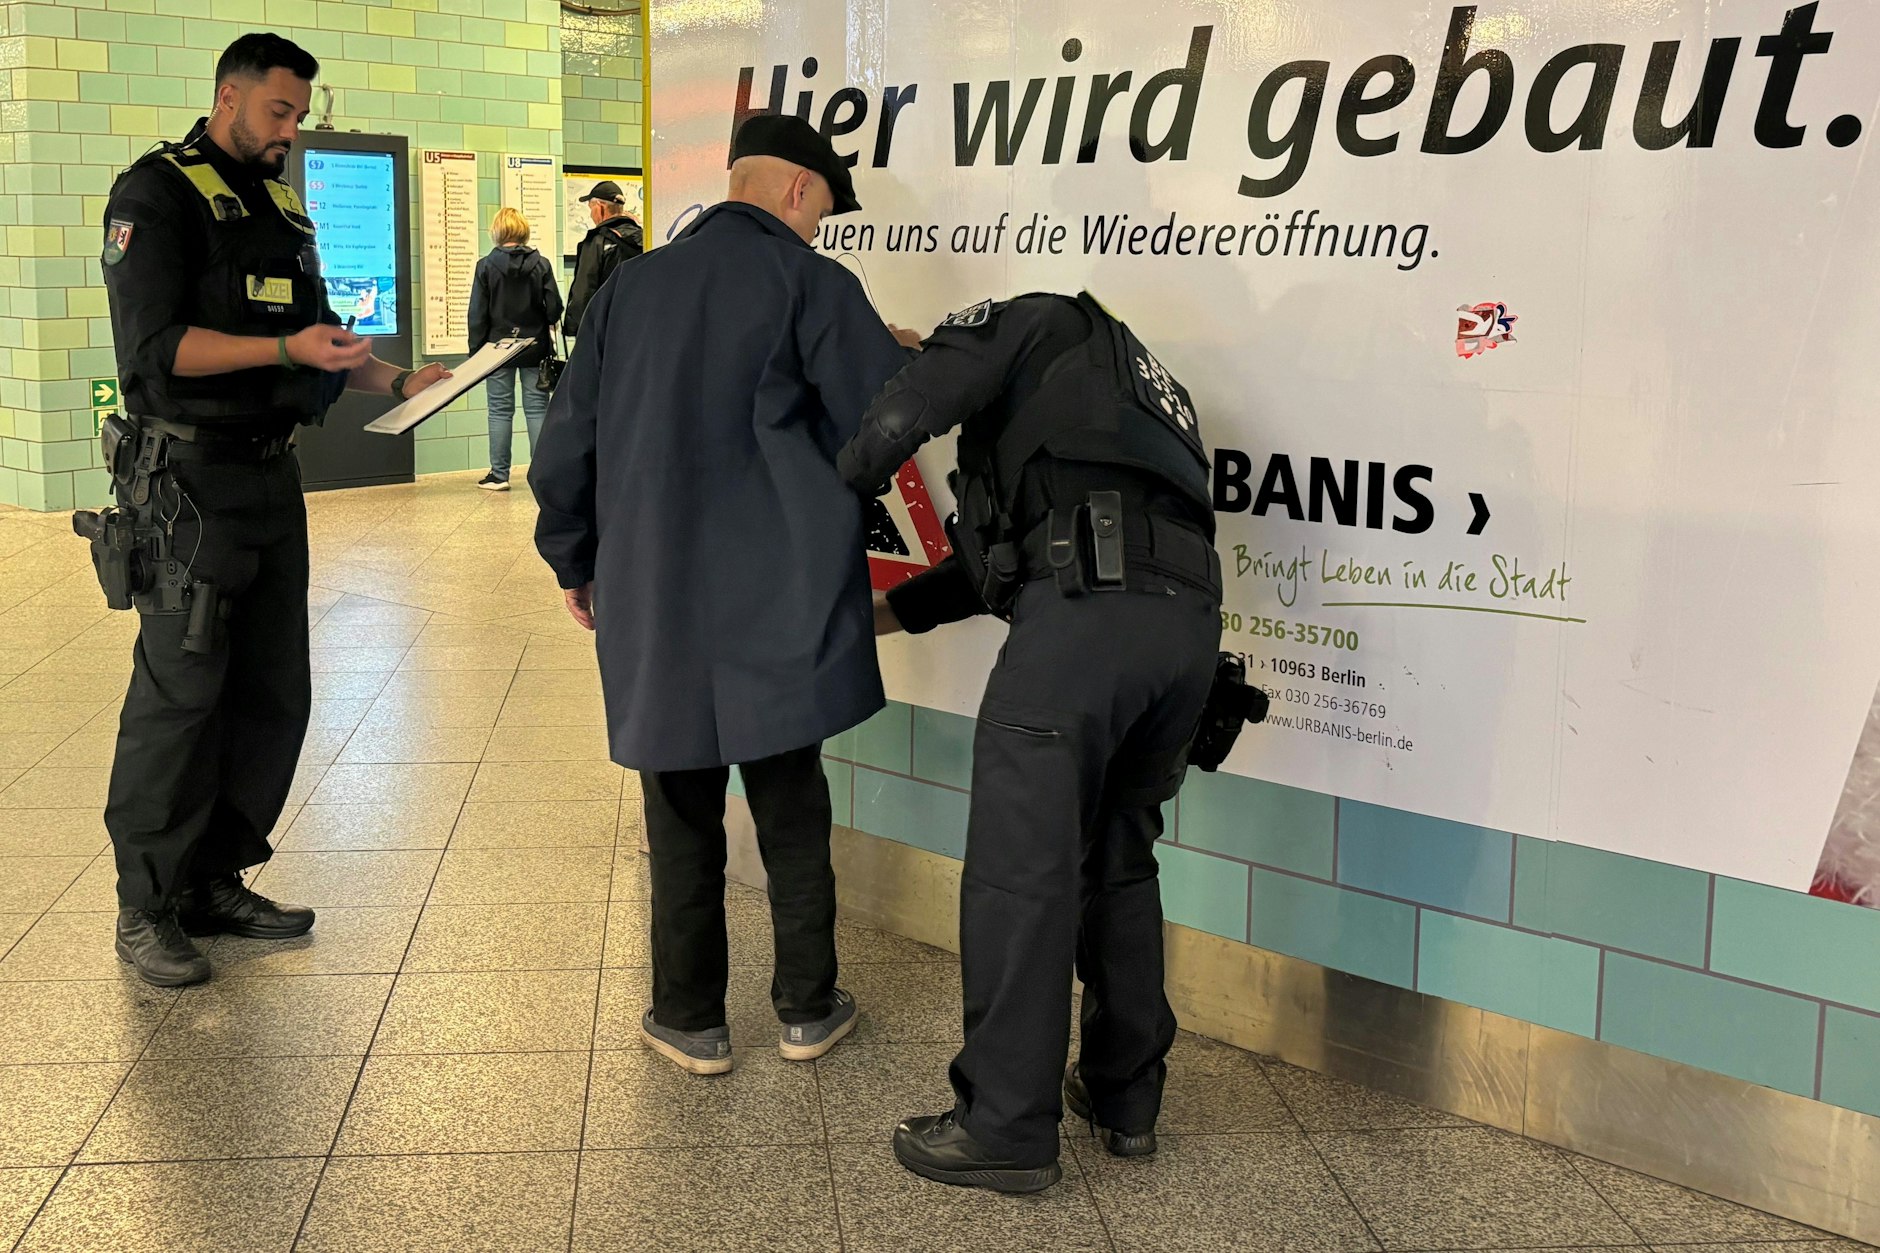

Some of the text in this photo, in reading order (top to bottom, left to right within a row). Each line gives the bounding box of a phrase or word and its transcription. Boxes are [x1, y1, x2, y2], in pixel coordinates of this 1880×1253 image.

[727, 0, 1862, 198] Hier wird gebaut.
[309, 160, 323, 169] S7
[425, 151, 441, 163] U5
[508, 157, 521, 168] U8
[319, 202, 326, 210] 12
[319, 222, 330, 230] M1
[811, 209, 1439, 271] euen uns auf die Wiedereröffnung.
[319, 242, 330, 250] M1
[1213, 448, 1435, 536] BANIS
[1233, 544, 1573, 608] Bringt Leben in die Stadt
[1220, 611, 1359, 651] 30 256-35700
[1271, 657, 1316, 679] 10963
[1321, 667, 1367, 688] Berlin
[1261, 684, 1387, 719] Fax 030 256-36769
[1263, 714, 1414, 752] www.URBANIS-berlin.de
